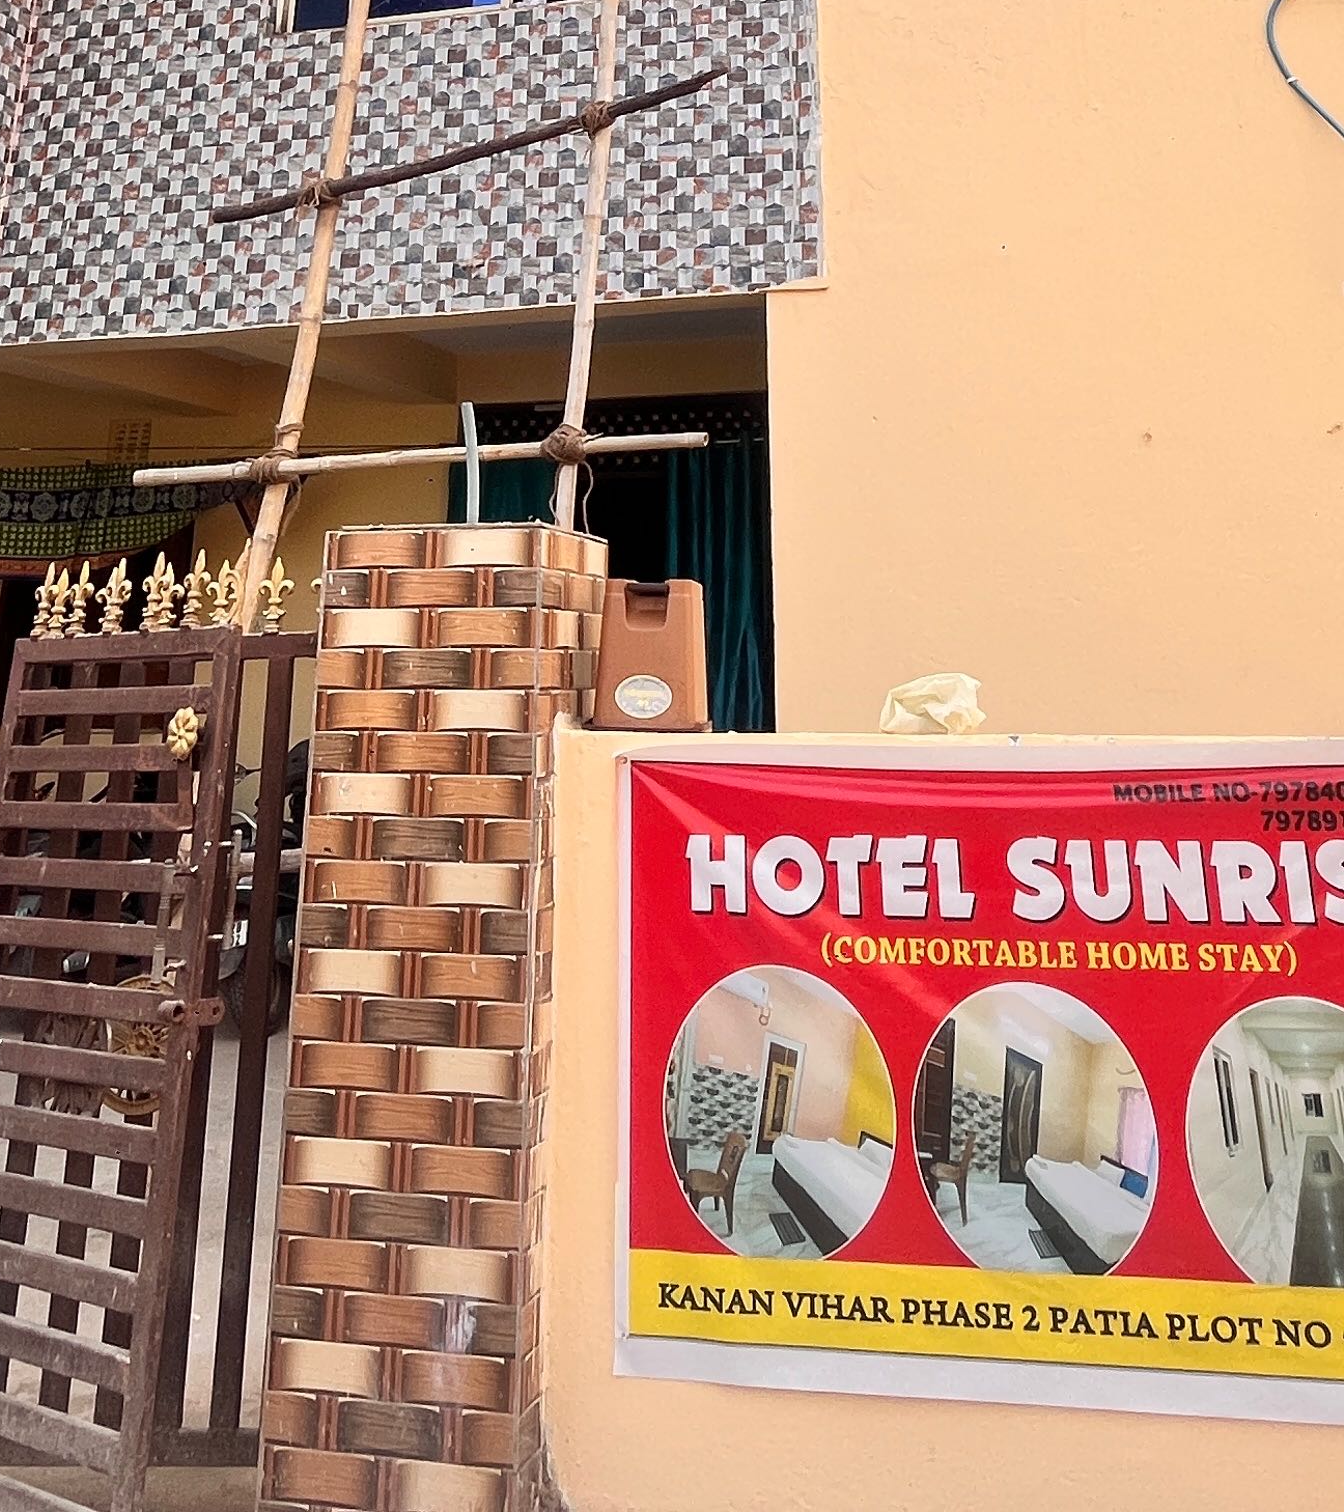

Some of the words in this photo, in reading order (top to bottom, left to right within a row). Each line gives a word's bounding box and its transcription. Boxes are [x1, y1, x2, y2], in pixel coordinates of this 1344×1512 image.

[1113, 783, 1205, 803] MOBILE
[685, 834, 976, 919] HOTEL
[821, 932, 1078, 969] (COMFORTABLE
[1086, 941, 1190, 972] HOME
[1198, 940, 1298, 977] STAY)
[657, 1282, 774, 1317] KANAN
[781, 1291, 895, 1324] VIHAR
[901, 1298, 1014, 1332] PHASE
[1021, 1305, 1041, 1333] 2
[1049, 1306, 1159, 1340] PATIA
[1165, 1313, 1263, 1346] PLOT
[1274, 1318, 1332, 1349] NO
